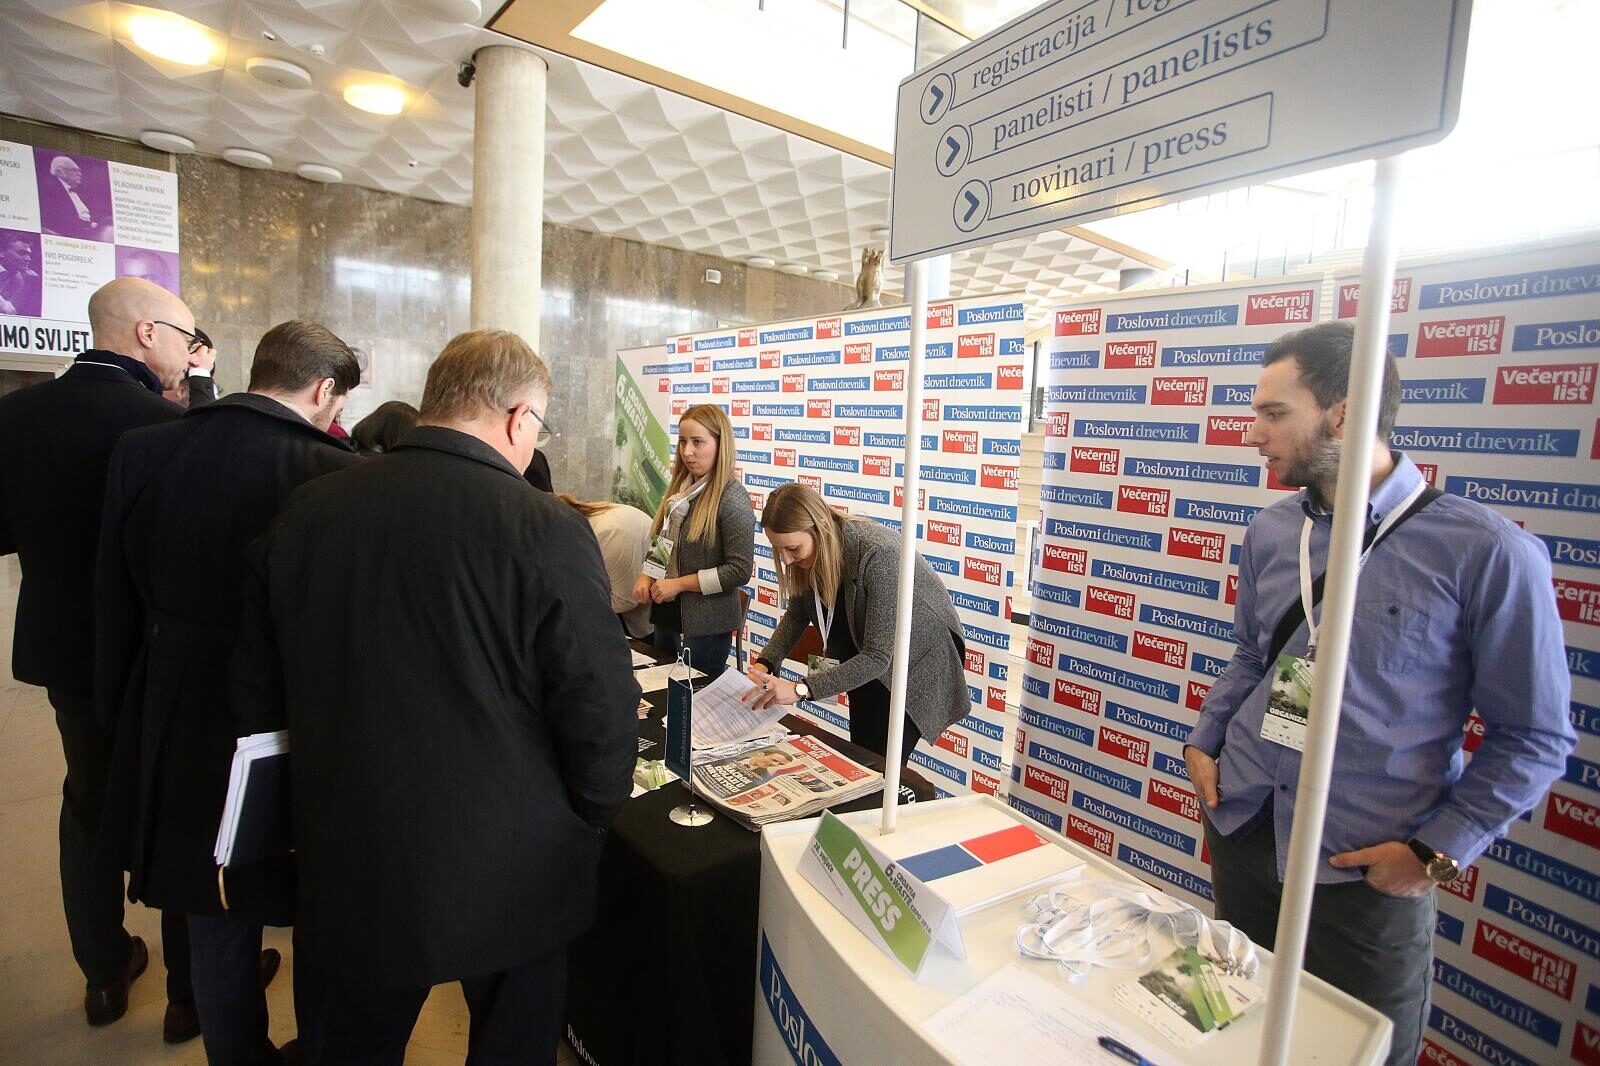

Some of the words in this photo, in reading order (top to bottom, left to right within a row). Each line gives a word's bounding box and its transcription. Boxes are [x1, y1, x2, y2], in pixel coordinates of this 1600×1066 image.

[972, 12, 1096, 90] registracija
[993, 82, 1093, 150] panelisti
[1102, 73, 1114, 104] /
[1121, 18, 1273, 105] panelists
[1012, 148, 1115, 203] novinari
[1124, 141, 1136, 171] /
[1140, 121, 1227, 174] press
[1251, 292, 1311, 311] Večernji
[1437, 281, 1528, 305] Poslovni
[940, 315, 953, 327] list
[966, 308, 1004, 323] Poslovni
[1057, 310, 1099, 325] Večernji
[1117, 314, 1169, 331] Poslovni
[1170, 308, 1227, 328] dnevnik
[1284, 307, 1310, 321] list
[850, 321, 879, 334] Poslovni
[879, 317, 910, 331] dnevnik
[1081, 322, 1098, 334] list
[1423, 320, 1501, 344] Večernji
[35, 327, 90, 353] SVIJET
[959, 335, 994, 349] Večernji
[1467, 337, 1498, 355] list
[845, 344, 872, 356] Večernji
[860, 353, 872, 363] list
[979, 345, 994, 356] list
[1108, 342, 1155, 358] Večernji
[1173, 348, 1231, 364] Poslovni
[787, 354, 812, 366] Poslovni
[811, 352, 837, 364] dnevnik
[1135, 354, 1153, 366] list
[812, 379, 838, 390] Poslovni
[838, 378, 866, 389] dnevnik
[876, 371, 903, 382] Večernji
[891, 380, 903, 390] list
[949, 375, 986, 388] dnevnik
[1501, 367, 1593, 389] Večernji
[1087, 387, 1137, 401] dnevnik
[1155, 378, 1206, 394] Večernji
[1552, 384, 1589, 401] list
[1184, 391, 1204, 404] list
[840, 406, 868, 417] Poslovni
[867, 406, 897, 417] dnevnik
[927, 409, 939, 420] list
[951, 407, 988, 420] Poslovni
[836, 427, 860, 440] Večernji
[1052, 424, 1067, 436] list
[1084, 422, 1134, 437] Poslovni
[1135, 424, 1189, 440] dnevnik
[849, 435, 860, 445] list
[869, 434, 899, 447] Poslovni
[945, 432, 977, 446] Večernji
[1465, 431, 1558, 452] dnevnik
[964, 442, 977, 454] list
[1073, 448, 1118, 465] Večernji
[864, 456, 891, 468] Večernji
[1098, 461, 1116, 473] list
[879, 466, 891, 476] list
[935, 469, 970, 484] dnevnik
[983, 465, 1018, 482] Večernji
[1135, 460, 1190, 478] Poslovni
[1191, 464, 1249, 483] dnevnik
[1003, 477, 1018, 490] list
[829, 485, 856, 499] Poslovni
[856, 489, 885, 502] dnevnik
[1057, 489, 1104, 506] dnevnik
[1121, 487, 1168, 506] Večernji
[1463, 481, 1559, 505] Poslovni
[936, 499, 972, 514] Poslovni
[972, 503, 1012, 520] dnevnik
[1147, 501, 1167, 515] list
[1186, 502, 1245, 523] Poslovni
[929, 521, 960, 537] Večernji
[1054, 522, 1101, 540] Poslovni
[1102, 529, 1152, 548] dnevnik
[947, 533, 960, 545] list
[973, 535, 1013, 553] Poslovni
[1172, 530, 1223, 550] Večernji
[1045, 546, 1085, 564] Večernji
[1201, 546, 1221, 561] list
[966, 558, 1000, 575] Večernji
[1067, 560, 1084, 573] list
[985, 572, 999, 584] list
[1102, 563, 1153, 585] Poslovni
[1154, 573, 1209, 595] dnevnik
[956, 594, 992, 613] dnevnik
[1089, 588, 1133, 608] Večernji
[1114, 604, 1132, 618] list
[1151, 609, 1207, 633] Poslovni
[1030, 614, 1070, 637] Poslovni
[1071, 626, 1119, 649] dnevnik
[1136, 633, 1185, 658] Večernji
[969, 660, 983, 673] list
[1036, 652, 1051, 666] list
[1164, 651, 1184, 667] list
[1069, 658, 1117, 683] Poslovni
[1117, 673, 1169, 698] dnevnik
[1057, 681, 1100, 706] Večernji
[1081, 699, 1098, 713] list
[1041, 716, 1086, 742] dnevnik
[1115, 707, 1168, 734] Poslovni
[1102, 728, 1147, 756] Večernji
[953, 744, 967, 758] list
[1127, 748, 1146, 764] list
[928, 758, 960, 781] dnevnik
[1038, 747, 1083, 774] Poslovni
[1084, 765, 1132, 793] dnevnik
[1027, 767, 1067, 791] Večernji
[1050, 786, 1066, 801] list
[1152, 781, 1201, 808] Večernji
[1012, 799, 1055, 826] dnevnik
[1180, 800, 1201, 820] list
[1070, 816, 1112, 846] Večernji
[1083, 797, 1131, 828] Poslovni
[1132, 818, 1185, 850] dnevnik
[1093, 837, 1111, 854] list
[1129, 851, 1183, 885] Poslovni
[842, 847, 903, 933] PRESS
[885, 862, 897, 882] 6.
[896, 872, 917, 901] CROATIA
[893, 879, 912, 907] WASTE
[1481, 923, 1572, 974] Večernji
[1531, 961, 1569, 1001] list
[1445, 966, 1541, 1033] dnevnik
